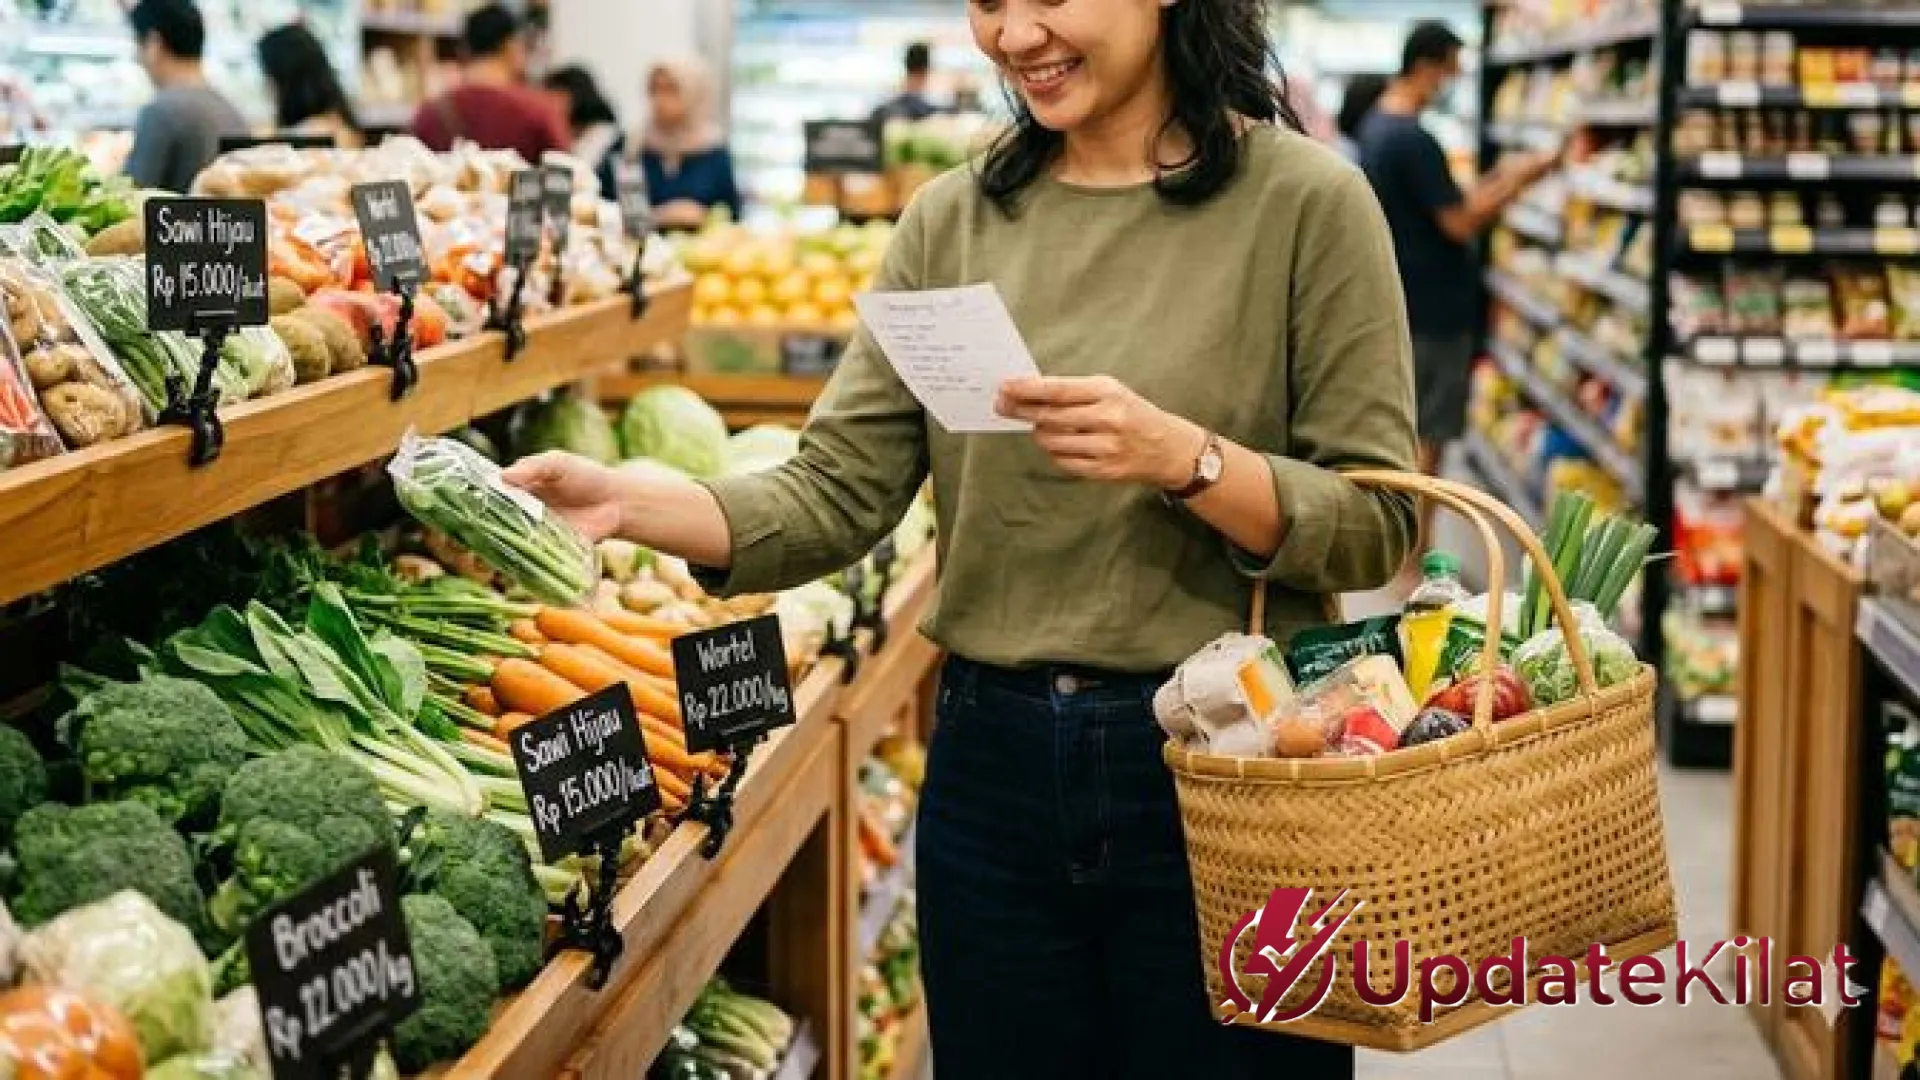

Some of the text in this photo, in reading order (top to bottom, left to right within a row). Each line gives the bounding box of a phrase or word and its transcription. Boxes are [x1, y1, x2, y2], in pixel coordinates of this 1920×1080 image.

[157, 205, 255, 256] Sawi Hijau
[152, 262, 175, 308] Rp
[695, 629, 757, 673] Wortel
[684, 669, 788, 730] Rp 22.000/kg
[520, 707, 623, 773] Sawi Hijau
[532, 794, 561, 836] Rp
[271, 868, 383, 971] Broccoli
[266, 1005, 302, 1060] Rp
